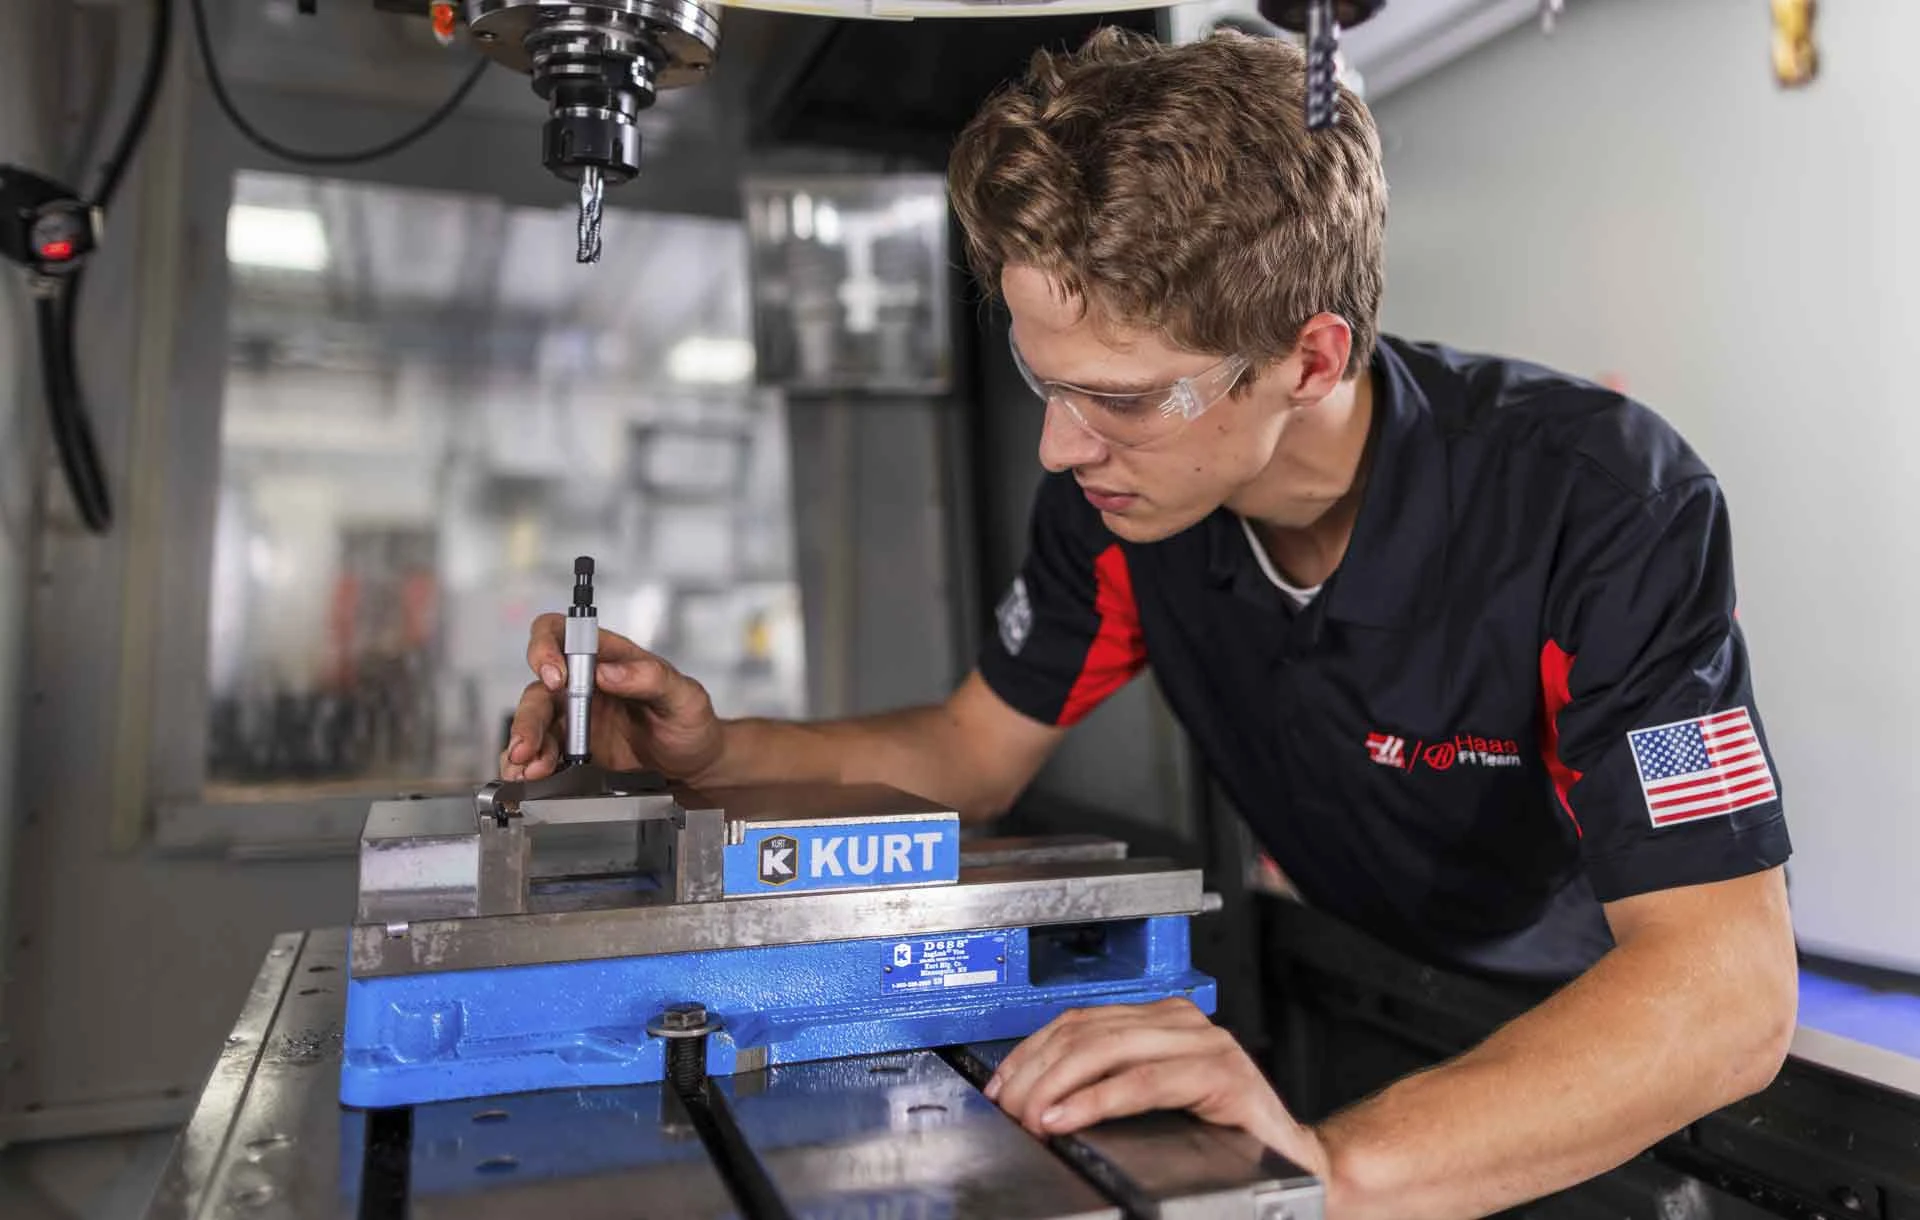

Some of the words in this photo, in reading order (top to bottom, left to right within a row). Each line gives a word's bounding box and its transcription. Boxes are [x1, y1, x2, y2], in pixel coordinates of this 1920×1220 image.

[1455, 735, 1519, 753] Haas
[1477, 751, 1521, 767] Team
[763, 848, 793, 875] K
[811, 832, 943, 877] KURT
